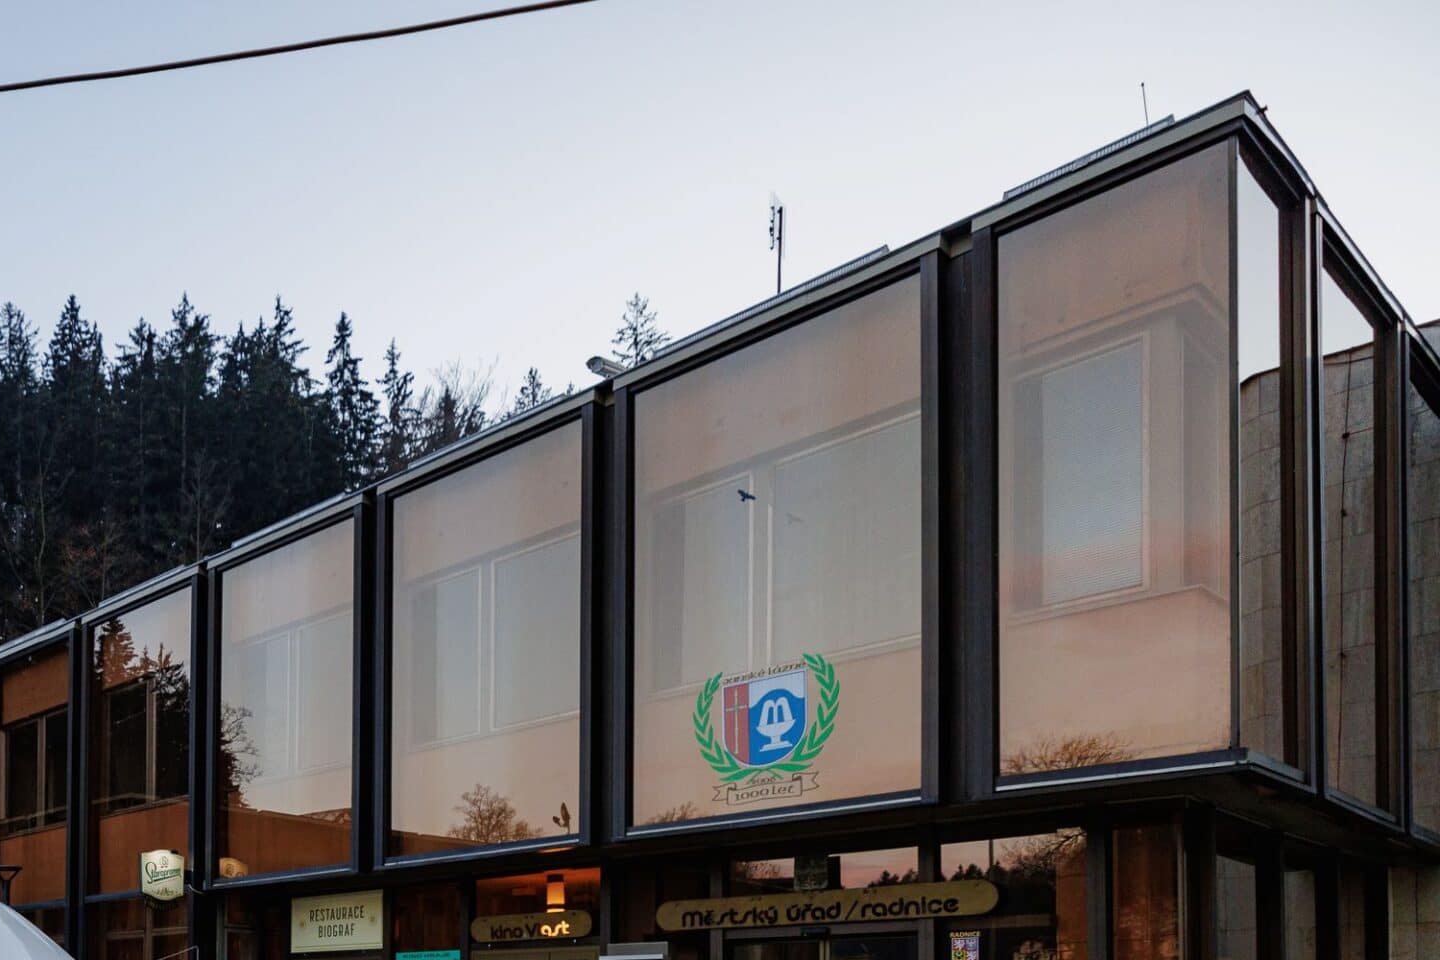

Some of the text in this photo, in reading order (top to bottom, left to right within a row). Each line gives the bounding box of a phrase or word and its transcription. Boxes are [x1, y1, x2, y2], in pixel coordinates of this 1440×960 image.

[309, 905, 365, 922] RESTAURACE
[786, 901, 841, 922] úřad
[318, 923, 356, 938] BIOGRAF
[490, 925, 523, 940] kino
